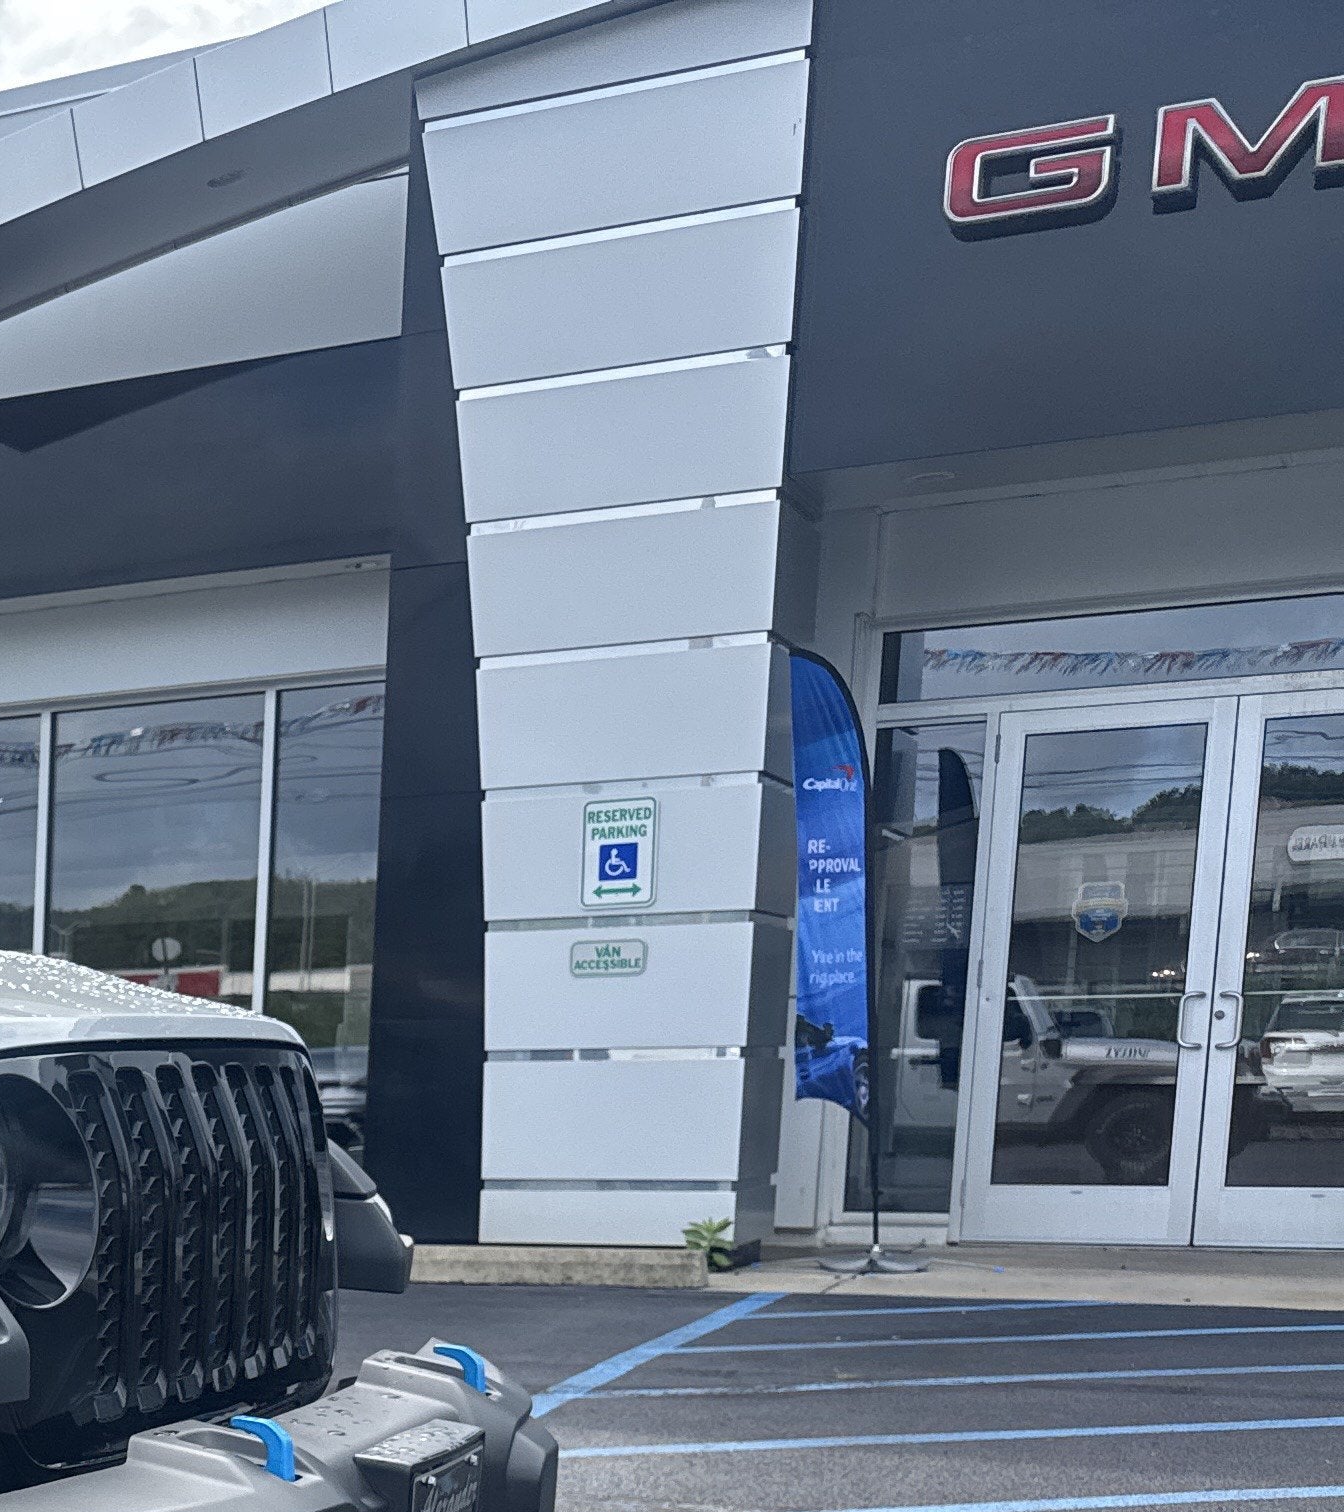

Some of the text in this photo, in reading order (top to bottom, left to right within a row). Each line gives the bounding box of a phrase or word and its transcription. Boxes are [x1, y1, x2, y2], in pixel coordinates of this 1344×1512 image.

[587, 807, 652, 824] RESERVED
[591, 824, 648, 841] PARKING
[594, 945, 621, 959] VAN
[573, 958, 642, 972] ACCESSIBLE
